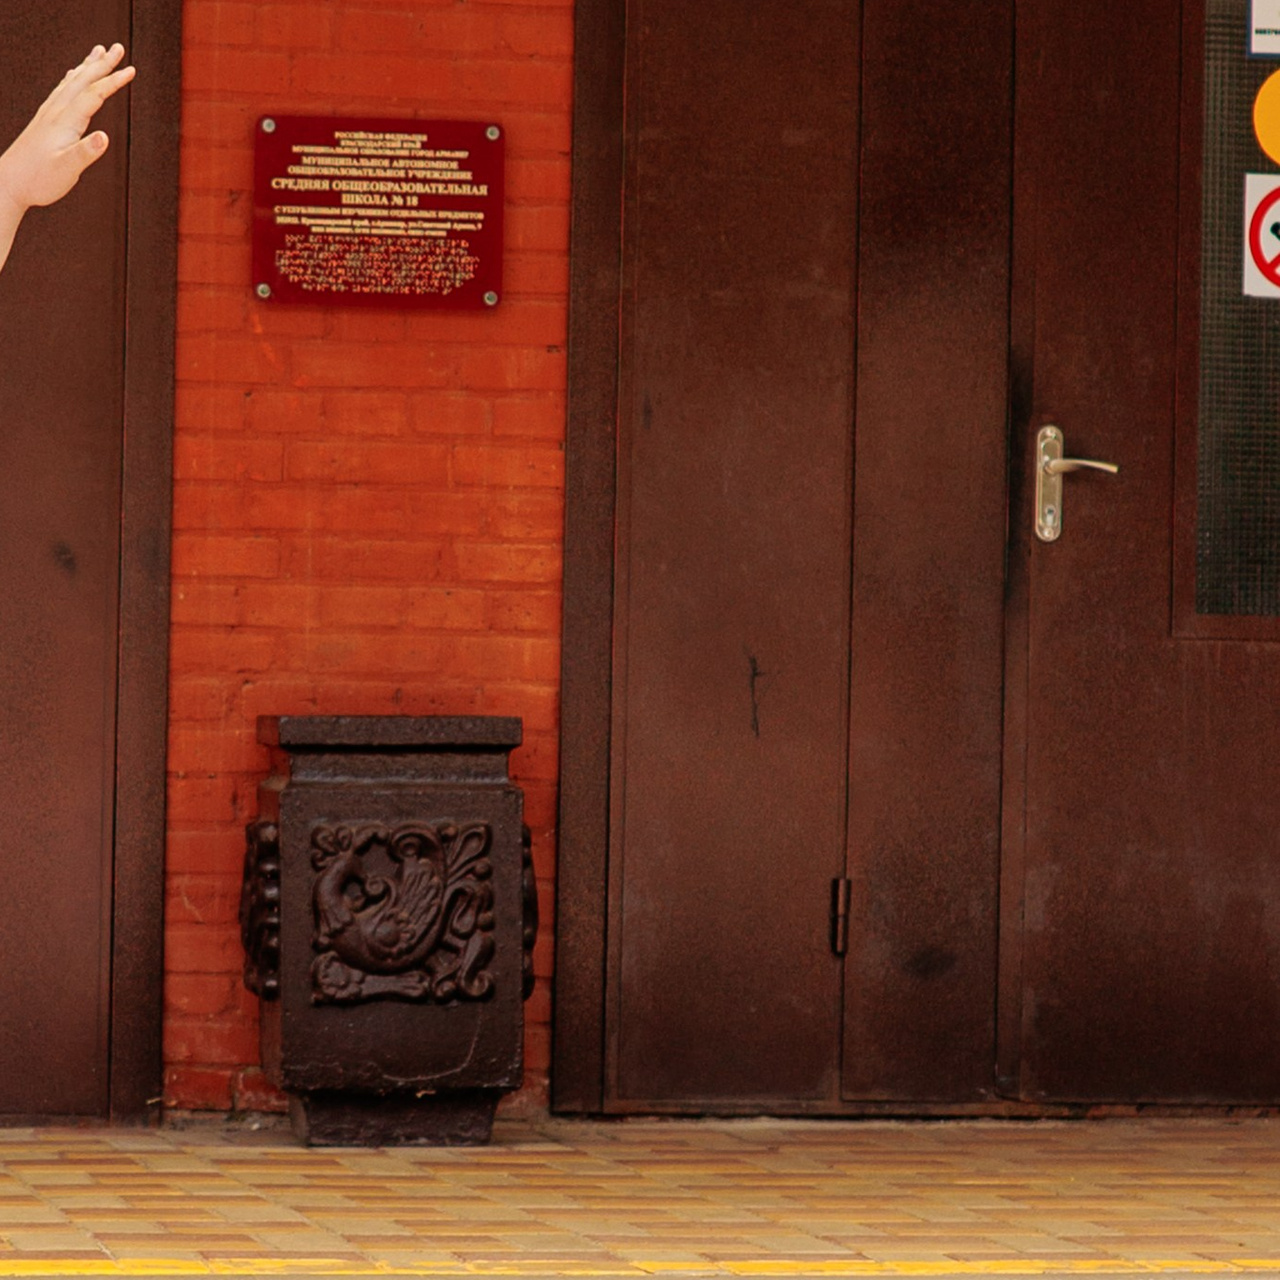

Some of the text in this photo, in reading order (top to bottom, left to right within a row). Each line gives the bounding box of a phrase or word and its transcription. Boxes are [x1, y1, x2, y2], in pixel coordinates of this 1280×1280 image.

[271, 178, 488, 196] СРЕДНЯЯ ОБЩЕОБРАЗОВАТЕЛЬНАЯ
[341, 194, 418, 207] ШКОЛА № 18
